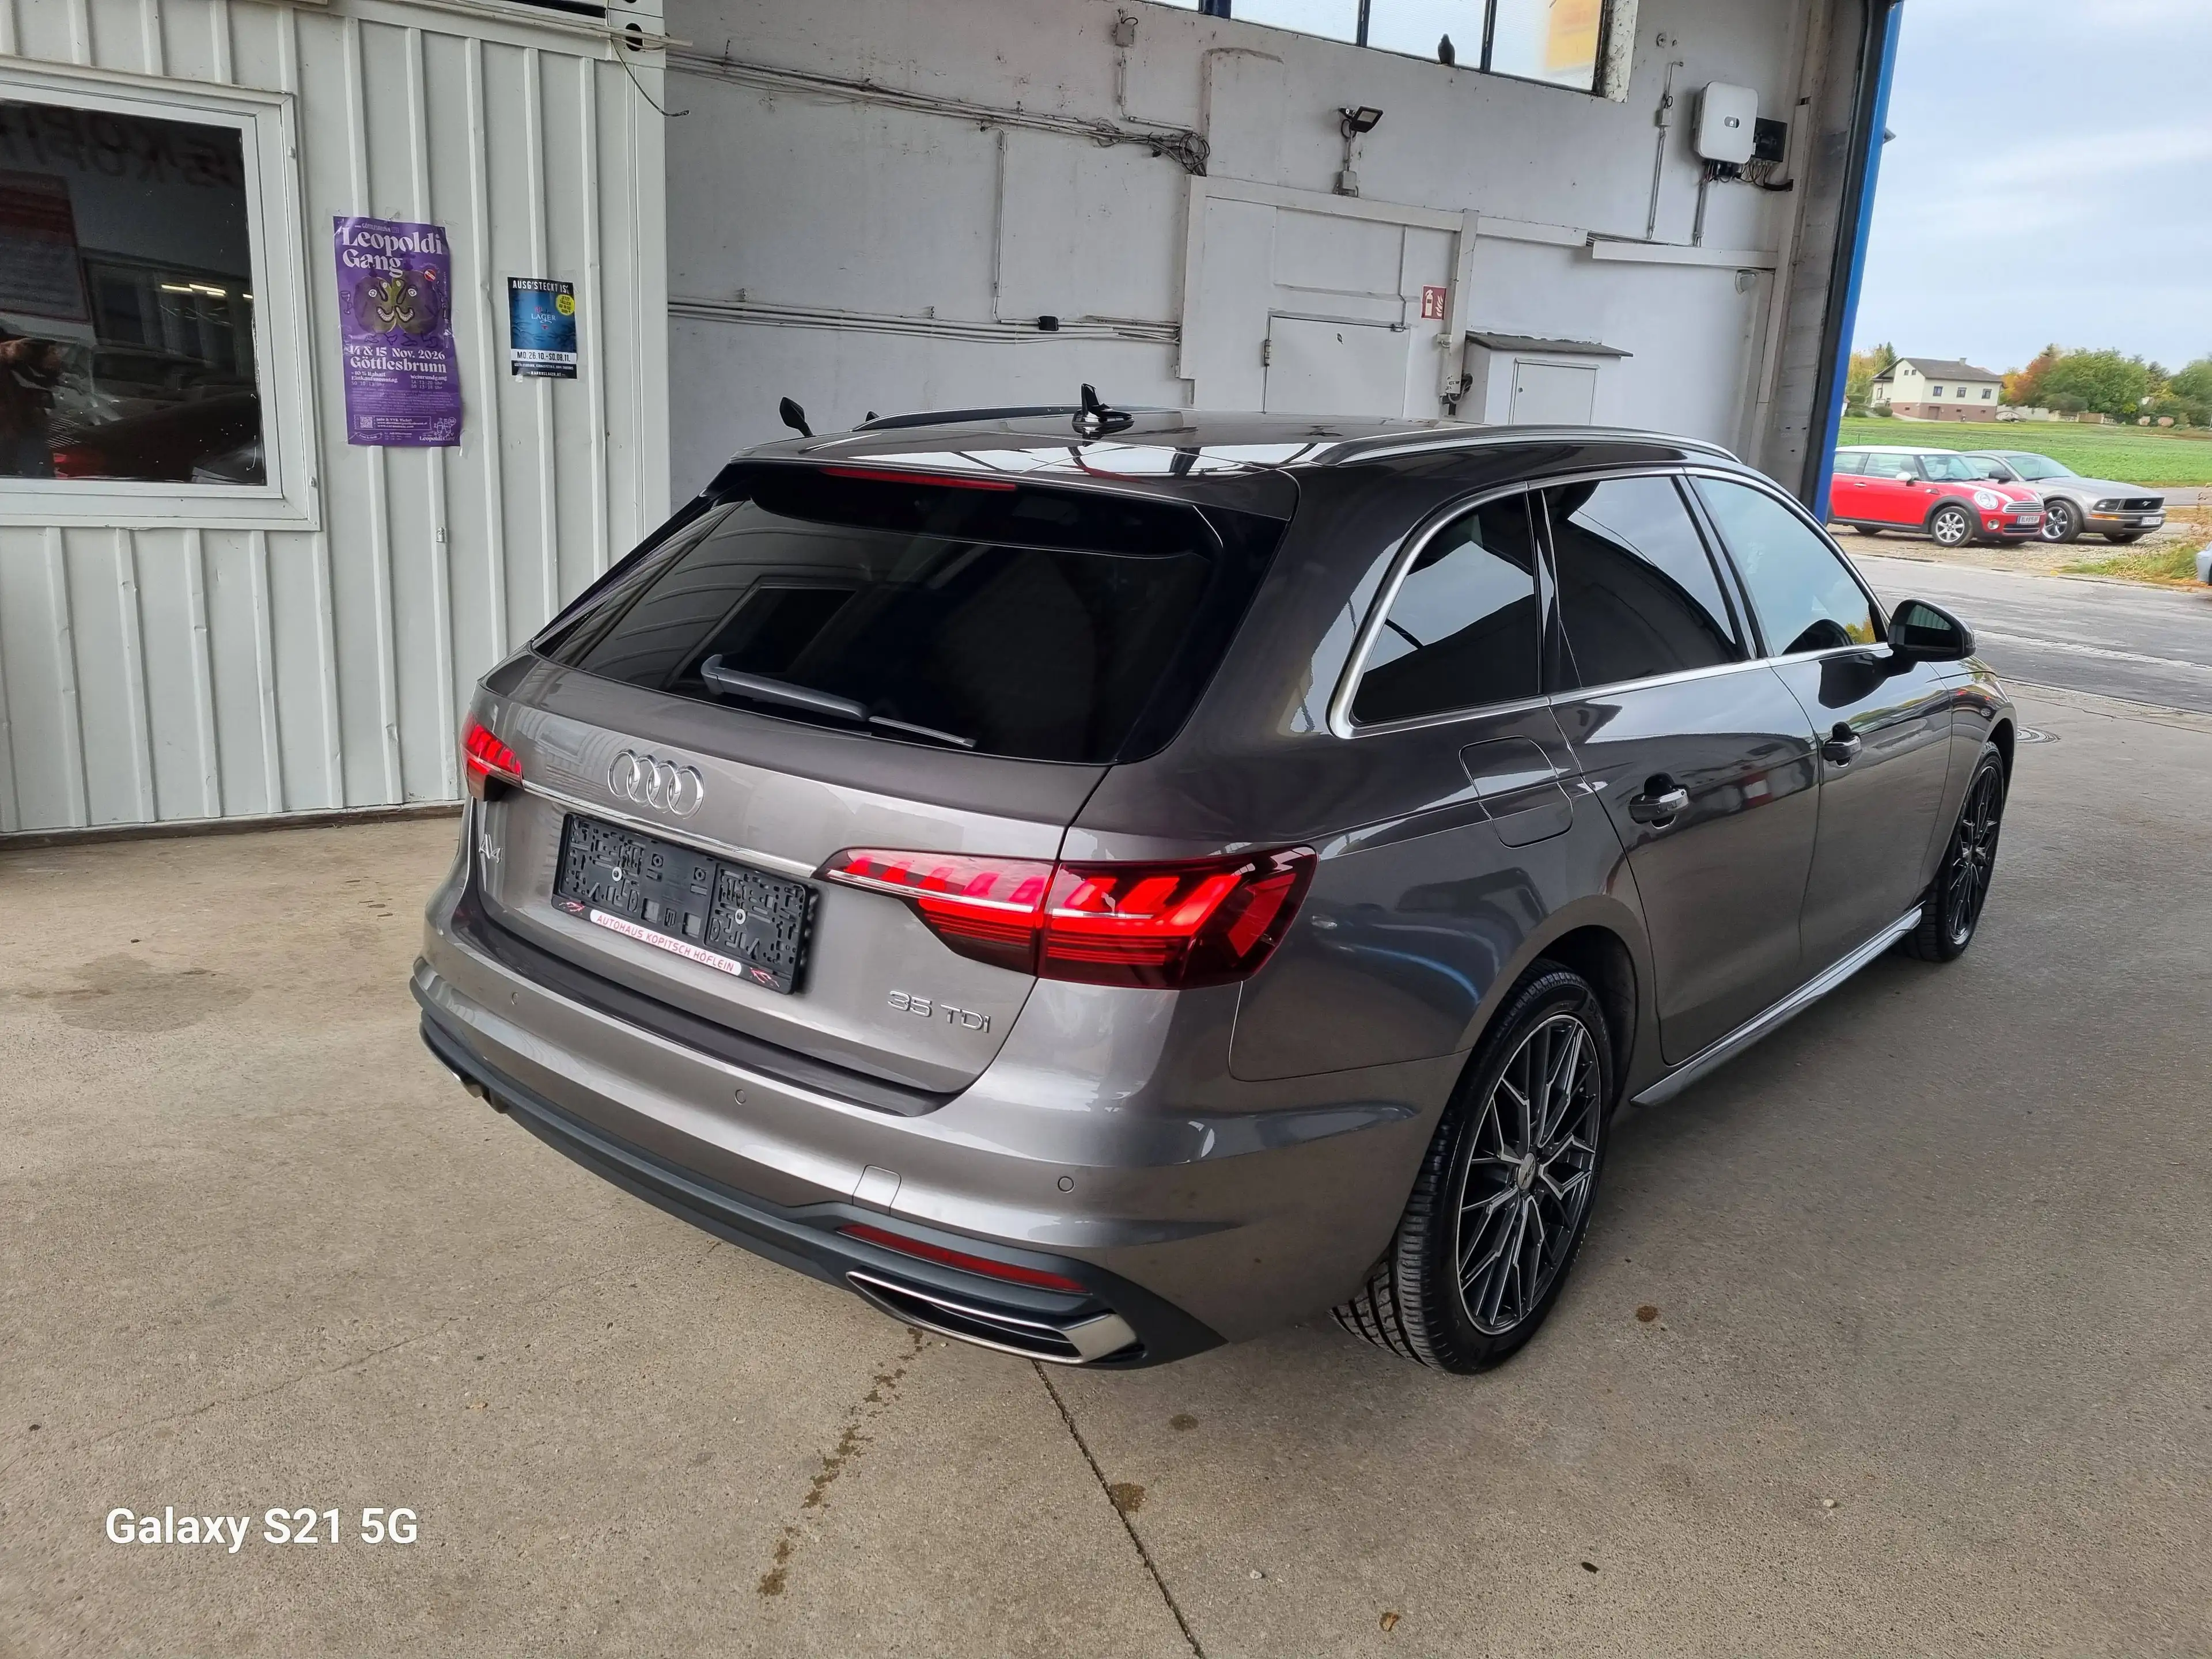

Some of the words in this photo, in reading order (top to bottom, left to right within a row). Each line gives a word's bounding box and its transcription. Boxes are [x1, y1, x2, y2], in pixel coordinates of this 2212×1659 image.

[342, 227, 443, 257] Leopoldi
[343, 249, 403, 278] Gang
[531, 313, 556, 323] LAGER
[350, 356, 448, 373] Göttlesbrunn
[363, 346, 373, 356] &
[376, 347, 387, 357] 15
[392, 347, 415, 358] Nov.
[418, 349, 446, 360] 2026
[479, 834, 504, 864] A4
[597, 914, 644, 938] AUTOHAUS
[646, 934, 691, 956] KOPITSCH
[694, 950, 734, 972] HÖFLEIN
[887, 990, 932, 1017] 35
[940, 1003, 991, 1033] TDI
